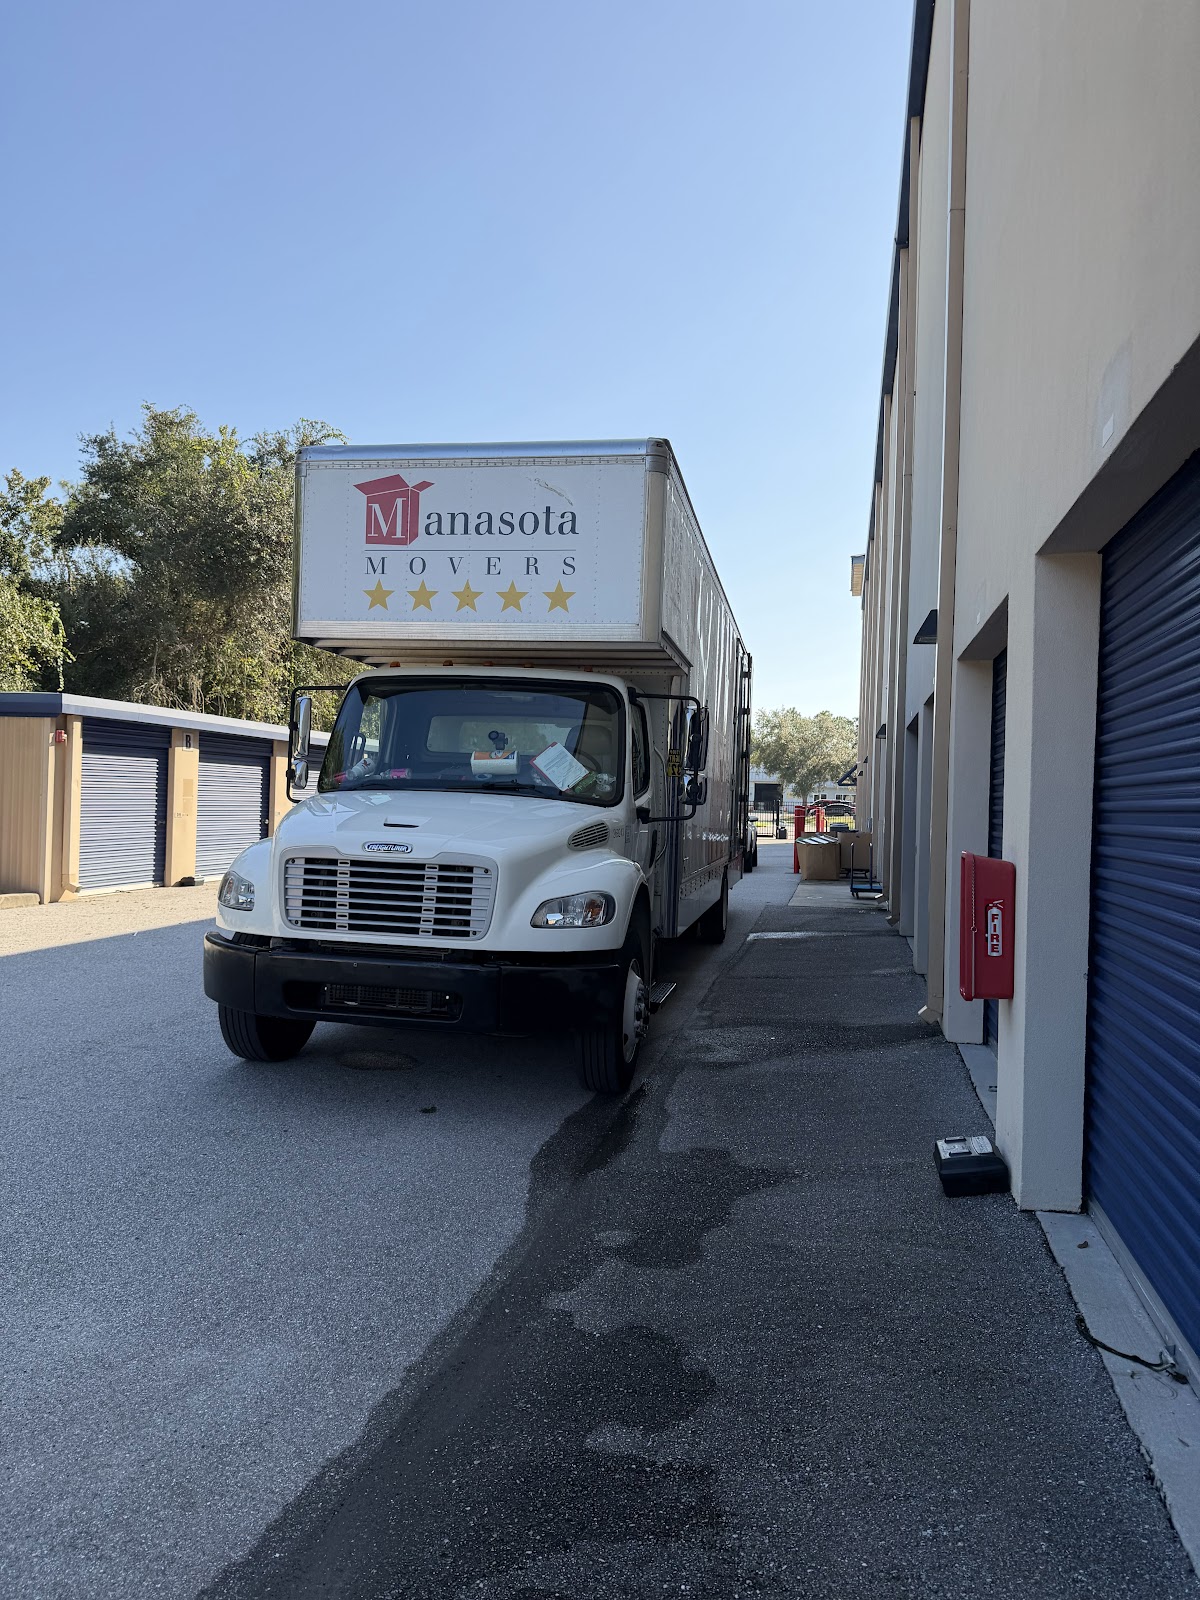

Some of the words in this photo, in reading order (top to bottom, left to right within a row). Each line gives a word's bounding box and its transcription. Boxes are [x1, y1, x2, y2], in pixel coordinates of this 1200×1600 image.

[367, 497, 580, 539] Manasota
[364, 556, 576, 576] MOVERS
[185, 734, 192, 749] B
[990, 913, 1000, 953] FIRE
